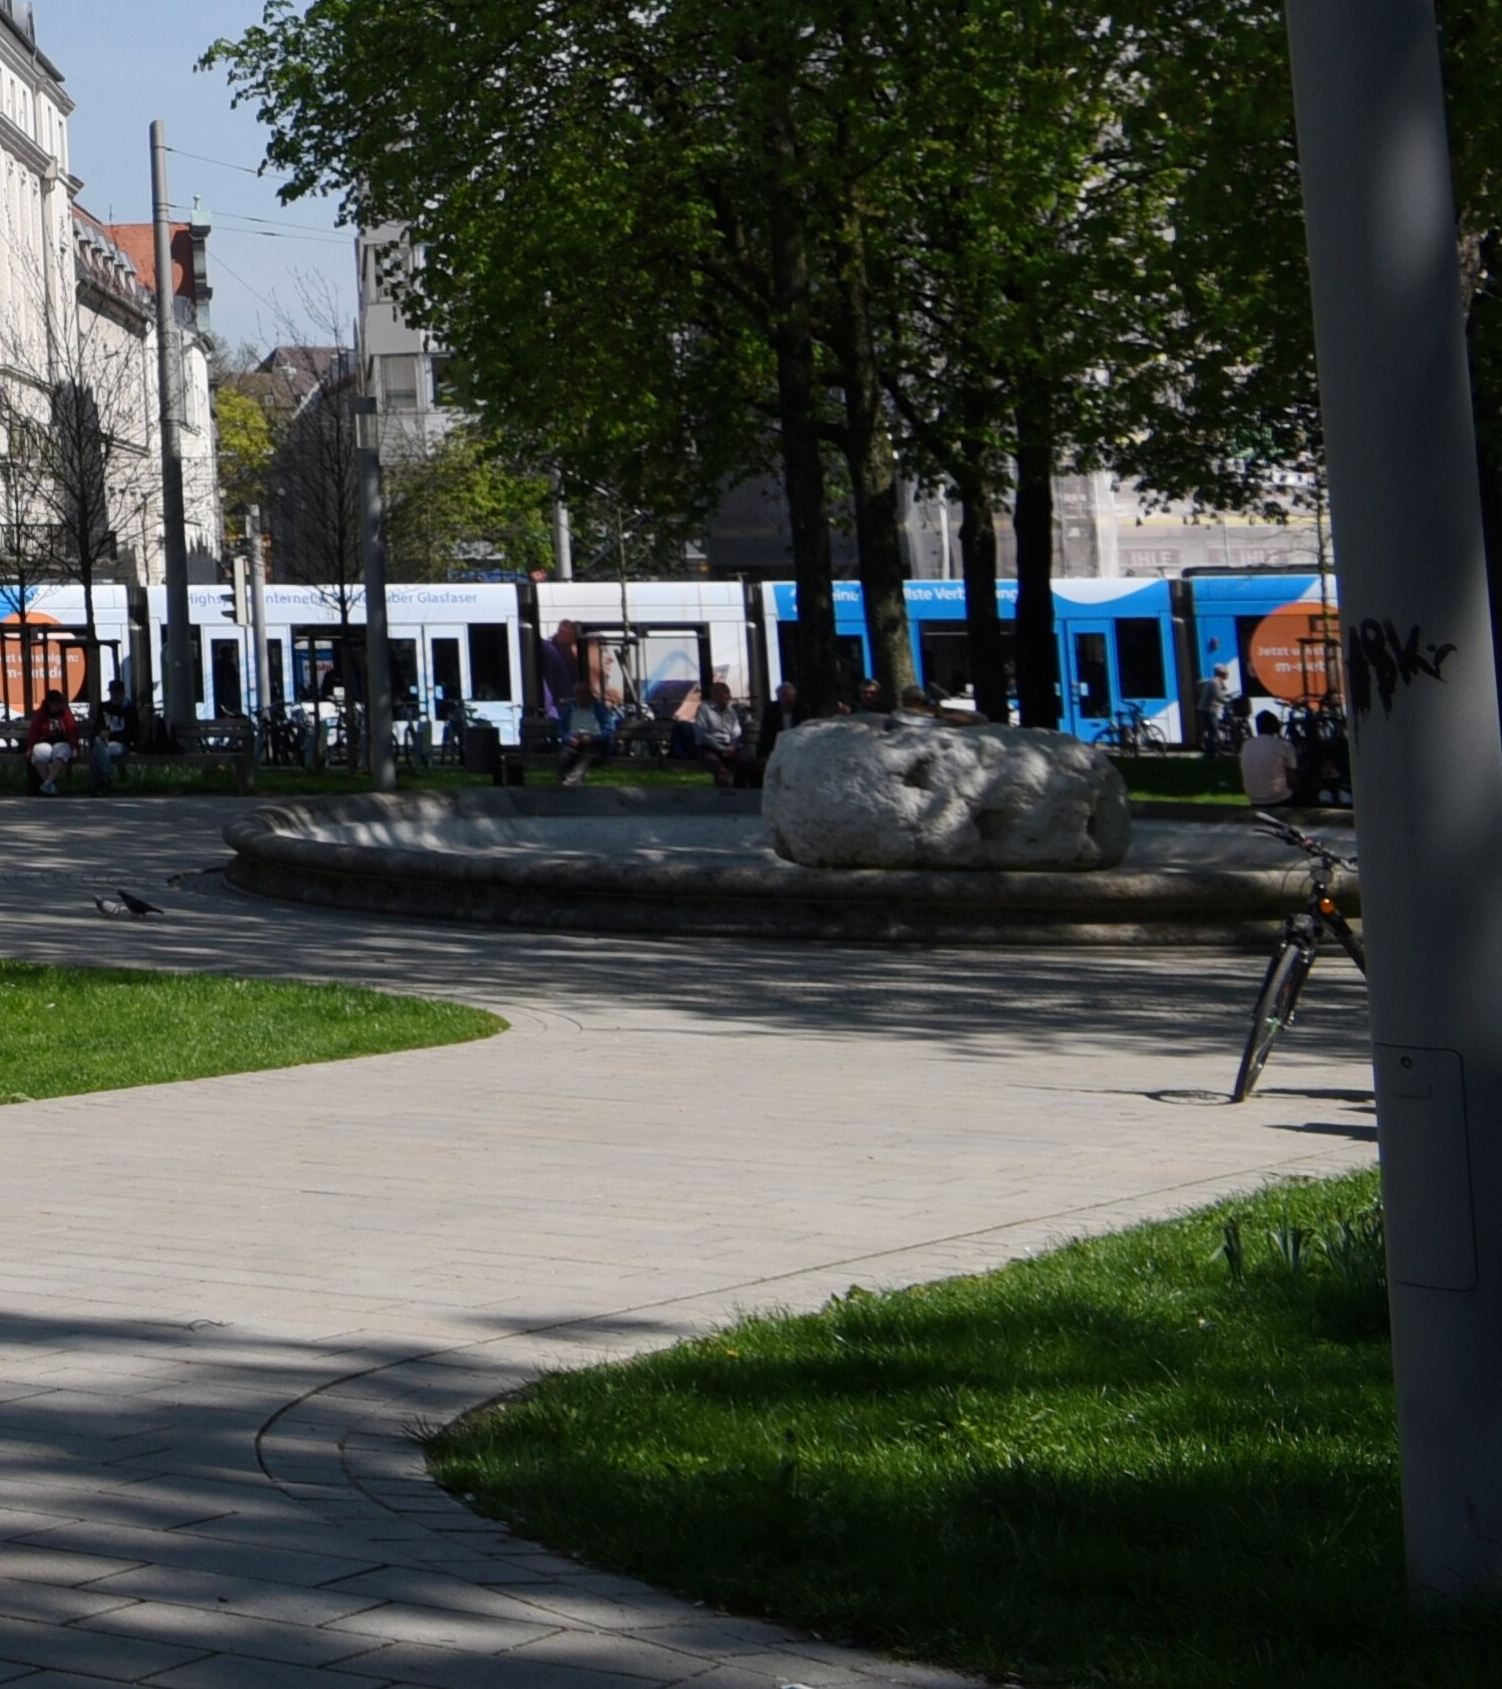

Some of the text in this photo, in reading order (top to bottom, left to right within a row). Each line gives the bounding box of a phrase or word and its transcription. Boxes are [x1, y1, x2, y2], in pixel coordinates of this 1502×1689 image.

[1131, 551, 1172, 565] IHLE
[266, 592, 317, 605] nternet
[417, 591, 478, 604] Glasfaser
